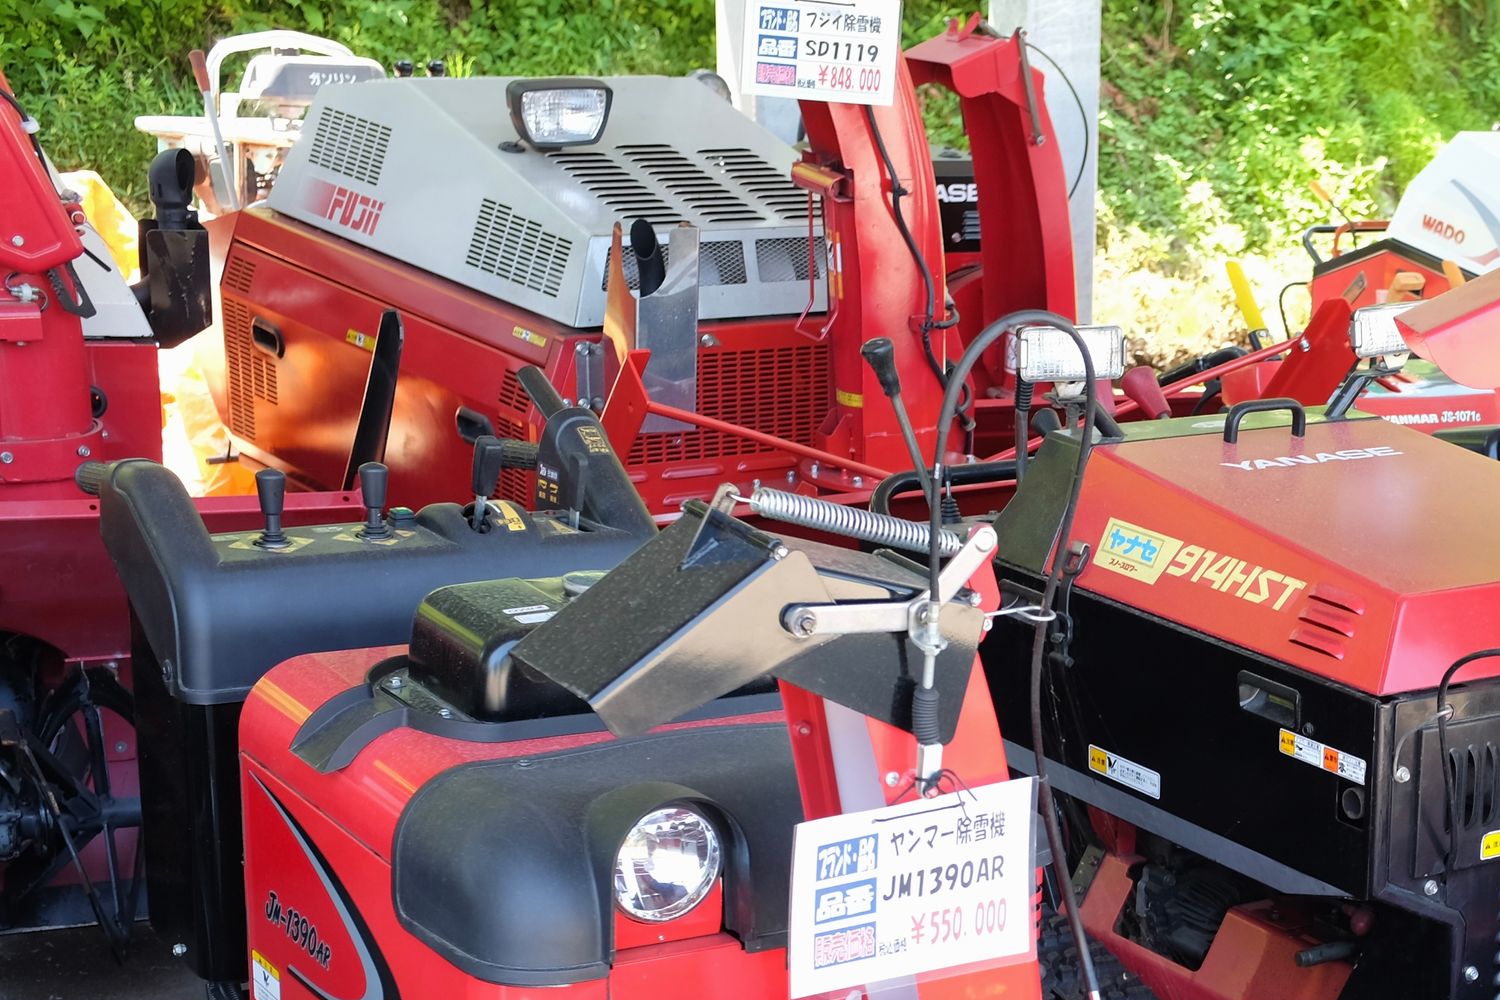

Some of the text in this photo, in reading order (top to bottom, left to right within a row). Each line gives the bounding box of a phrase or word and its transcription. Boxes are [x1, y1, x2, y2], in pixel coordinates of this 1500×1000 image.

[807, 12, 881, 33] フジイ除雪機
[806, 40, 879, 62] SD1119
[1423, 214, 1465, 245] WADO
[1219, 446, 1404, 471] YANASE
[1110, 528, 1158, 562] ヤナセ
[1165, 544, 1308, 611] 914HST
[890, 810, 1006, 857] ヤンマー除雪機
[816, 855, 1005, 922] 品番 JM1390AR
